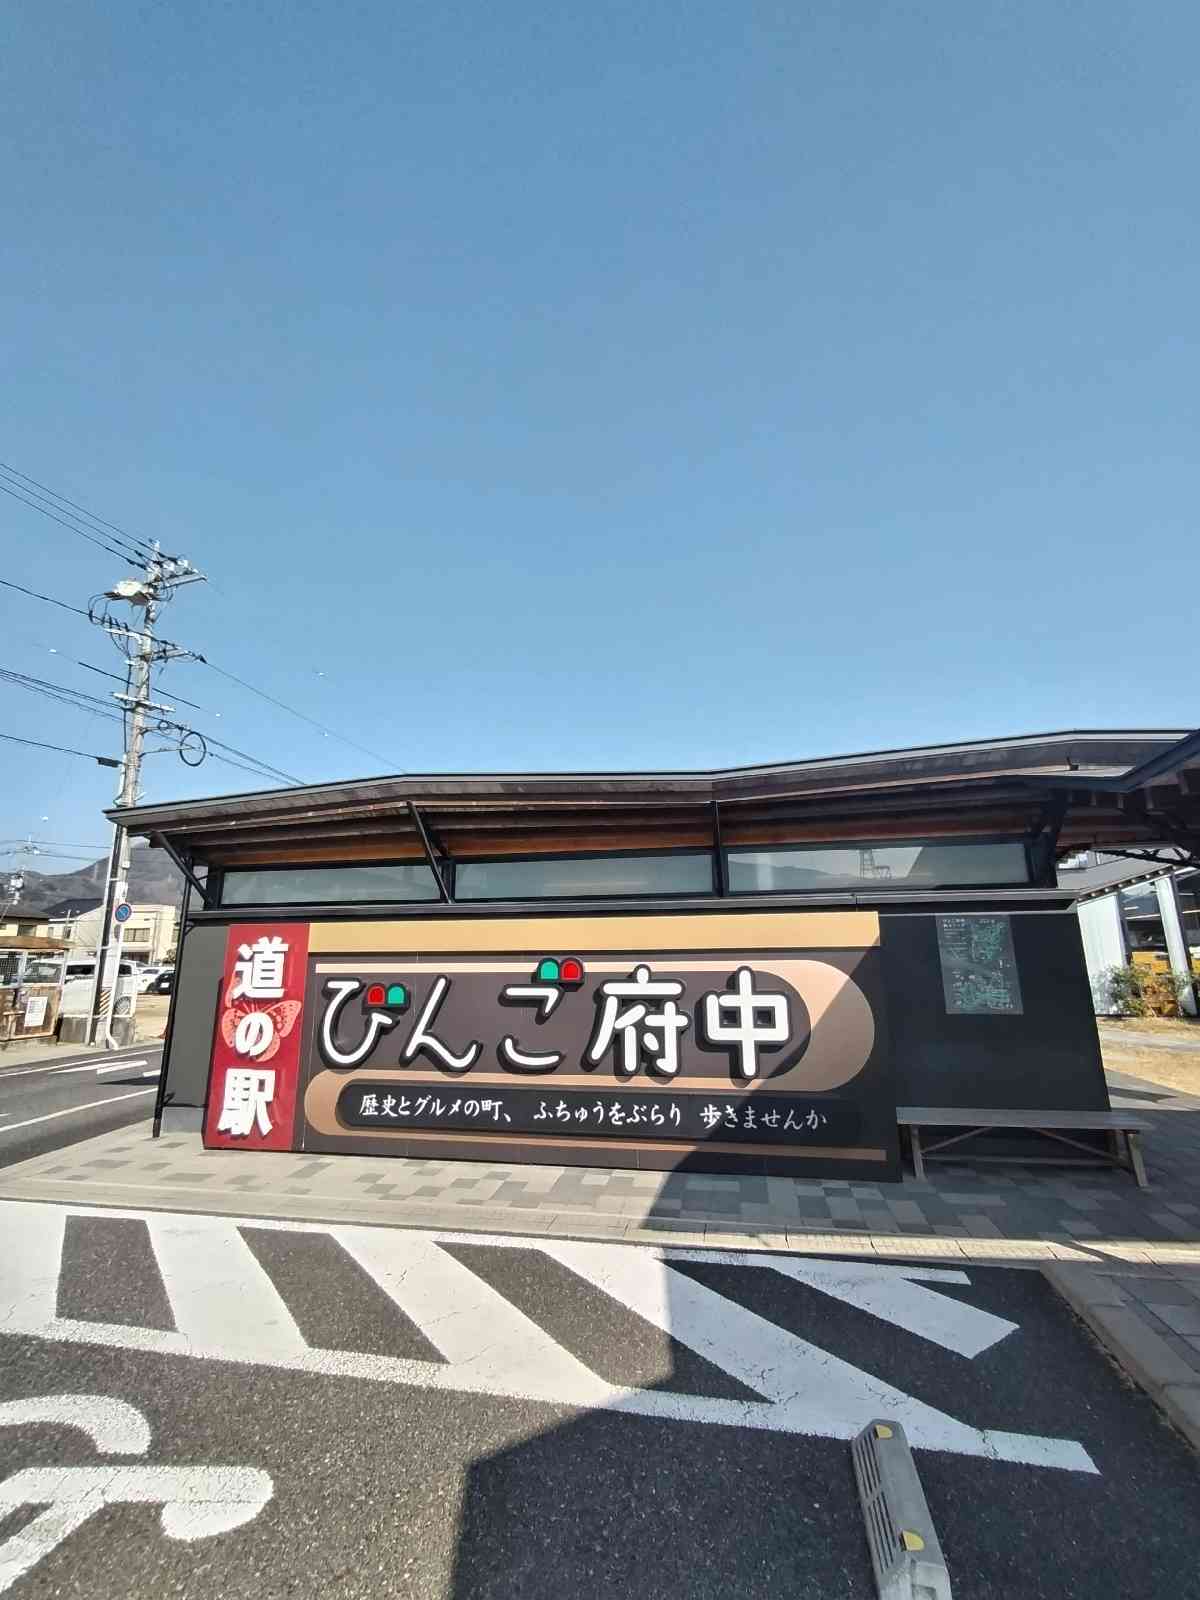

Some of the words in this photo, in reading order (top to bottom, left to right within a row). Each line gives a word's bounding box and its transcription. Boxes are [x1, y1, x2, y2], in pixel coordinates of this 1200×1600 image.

[216, 936, 289, 1137] 道の駅
[322, 959, 790, 1077] びんご府中
[359, 1094, 512, 1122] 歴史とグルメの町、
[533, 1100, 681, 1126] ふちゅうをぶらり
[699, 1104, 828, 1130] 歩きませんか
